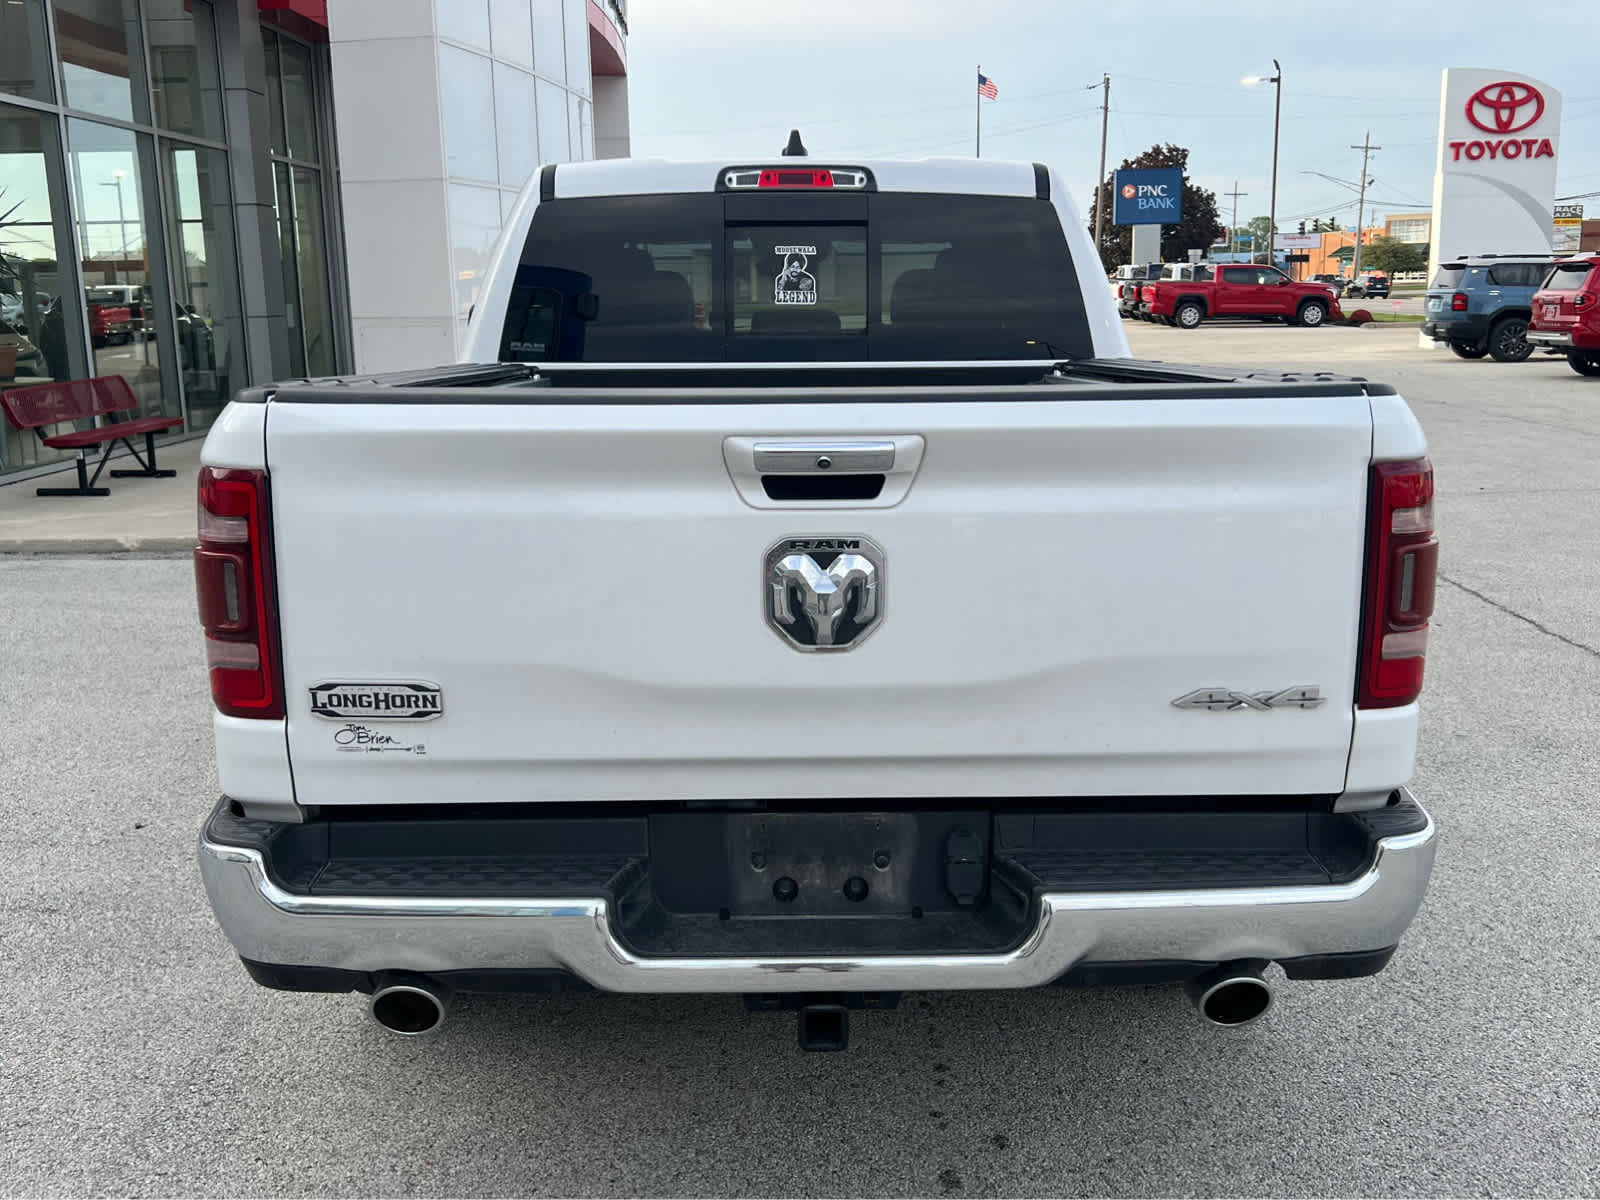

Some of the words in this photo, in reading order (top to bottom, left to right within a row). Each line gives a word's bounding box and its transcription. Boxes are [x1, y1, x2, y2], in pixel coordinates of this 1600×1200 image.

[1449, 138, 1554, 161] TOYOTA
[1138, 185, 1168, 196] PNC
[1138, 197, 1175, 209] BANK
[775, 290, 816, 303] LEGEND
[790, 540, 860, 549] RAM
[345, 723, 372, 733] Tom
